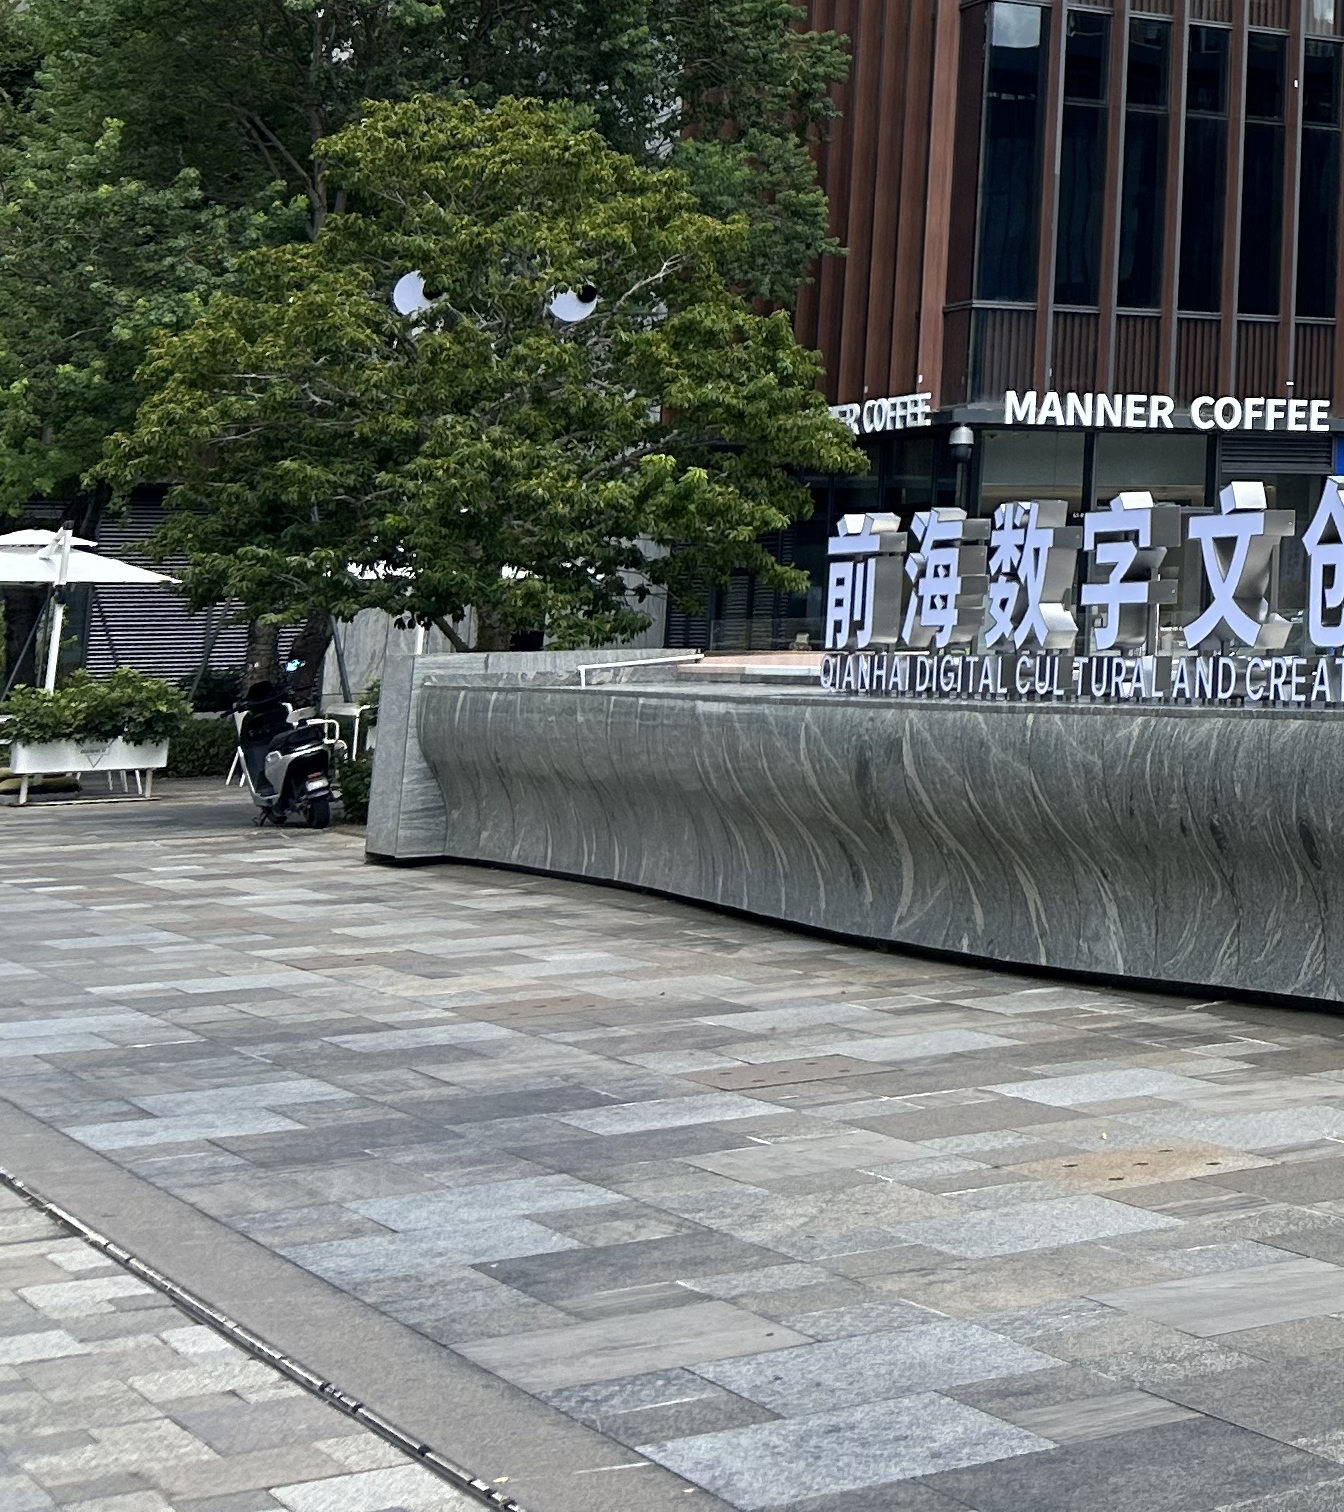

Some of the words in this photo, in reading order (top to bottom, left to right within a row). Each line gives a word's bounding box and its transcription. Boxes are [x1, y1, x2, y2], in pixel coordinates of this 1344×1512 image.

[862, 392, 932, 434] COFFEE
[1004, 390, 1175, 429] MANNER
[1190, 395, 1331, 432] COFFEE
[820, 655, 909, 692] QIANHAI
[915, 656, 1007, 695] DIGITAL
[1172, 656, 1237, 700] AND
